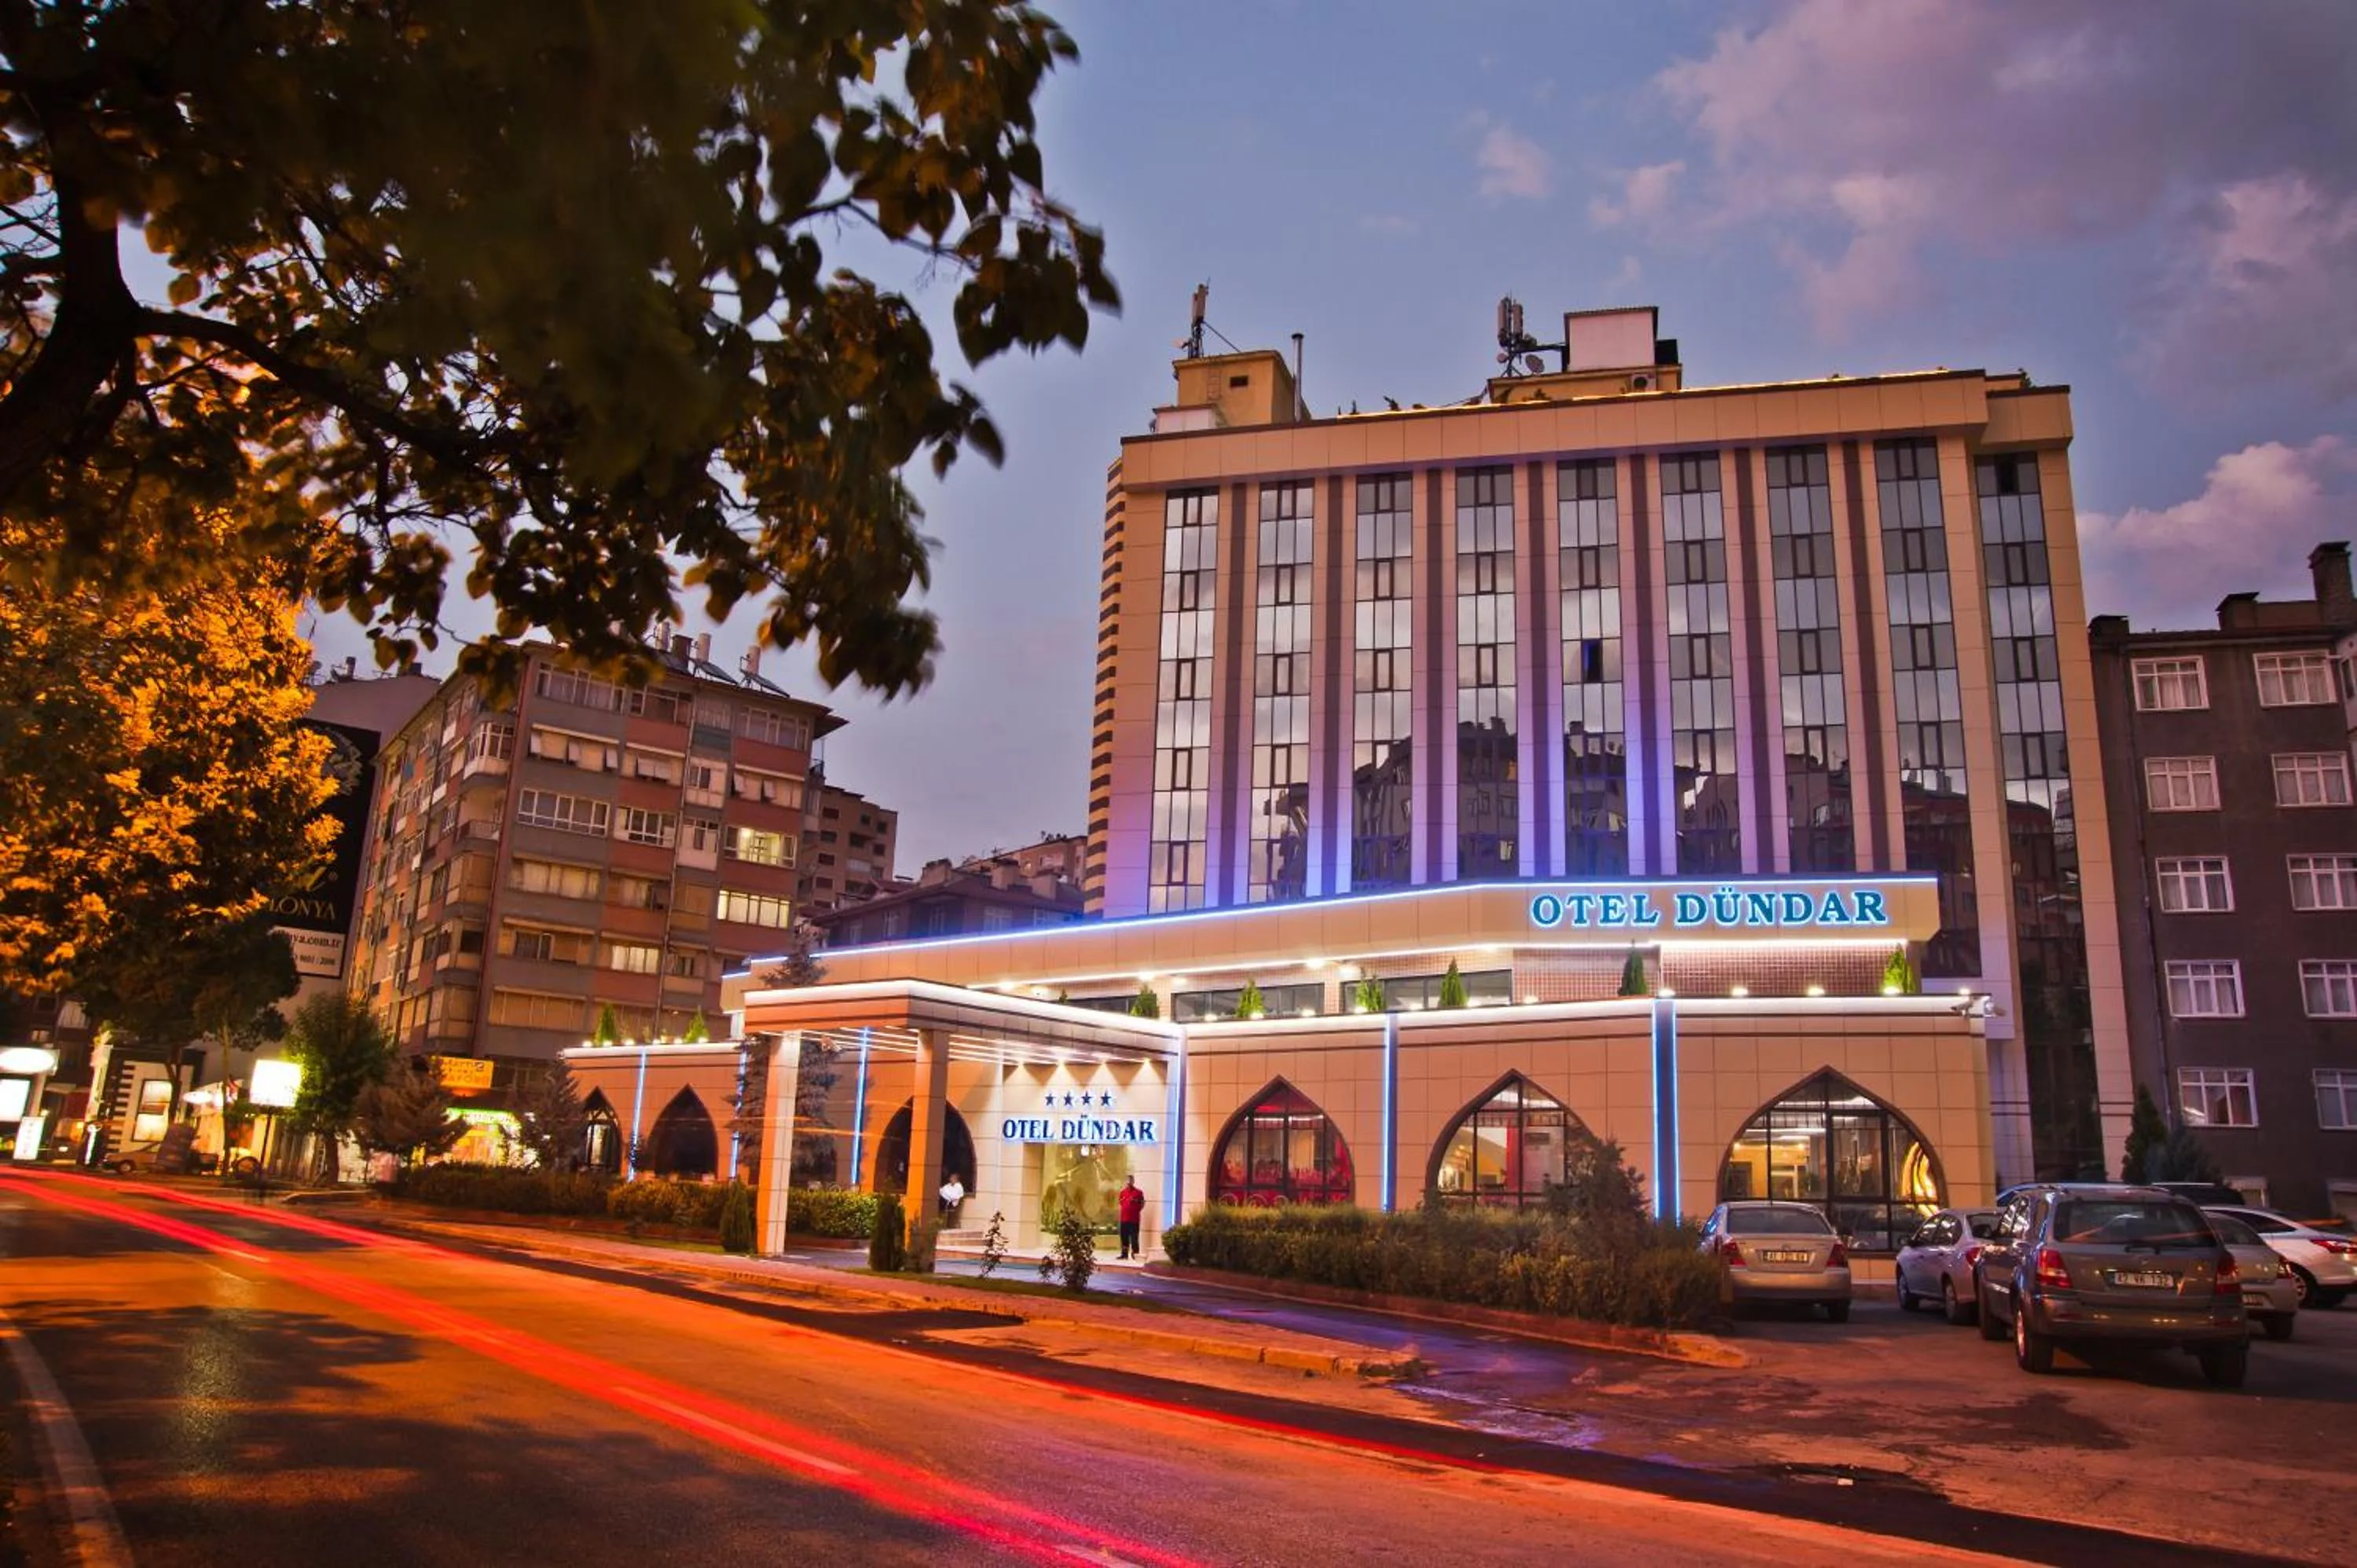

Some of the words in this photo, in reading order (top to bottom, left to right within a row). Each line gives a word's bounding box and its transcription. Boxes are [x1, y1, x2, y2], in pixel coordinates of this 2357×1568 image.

[1532, 893, 1659, 925] OTEL
[1676, 888, 1887, 925] DÜNDAR
[1003, 1119, 1054, 1139] OTEL
[1061, 1114, 1155, 1141] DÜNDAR
